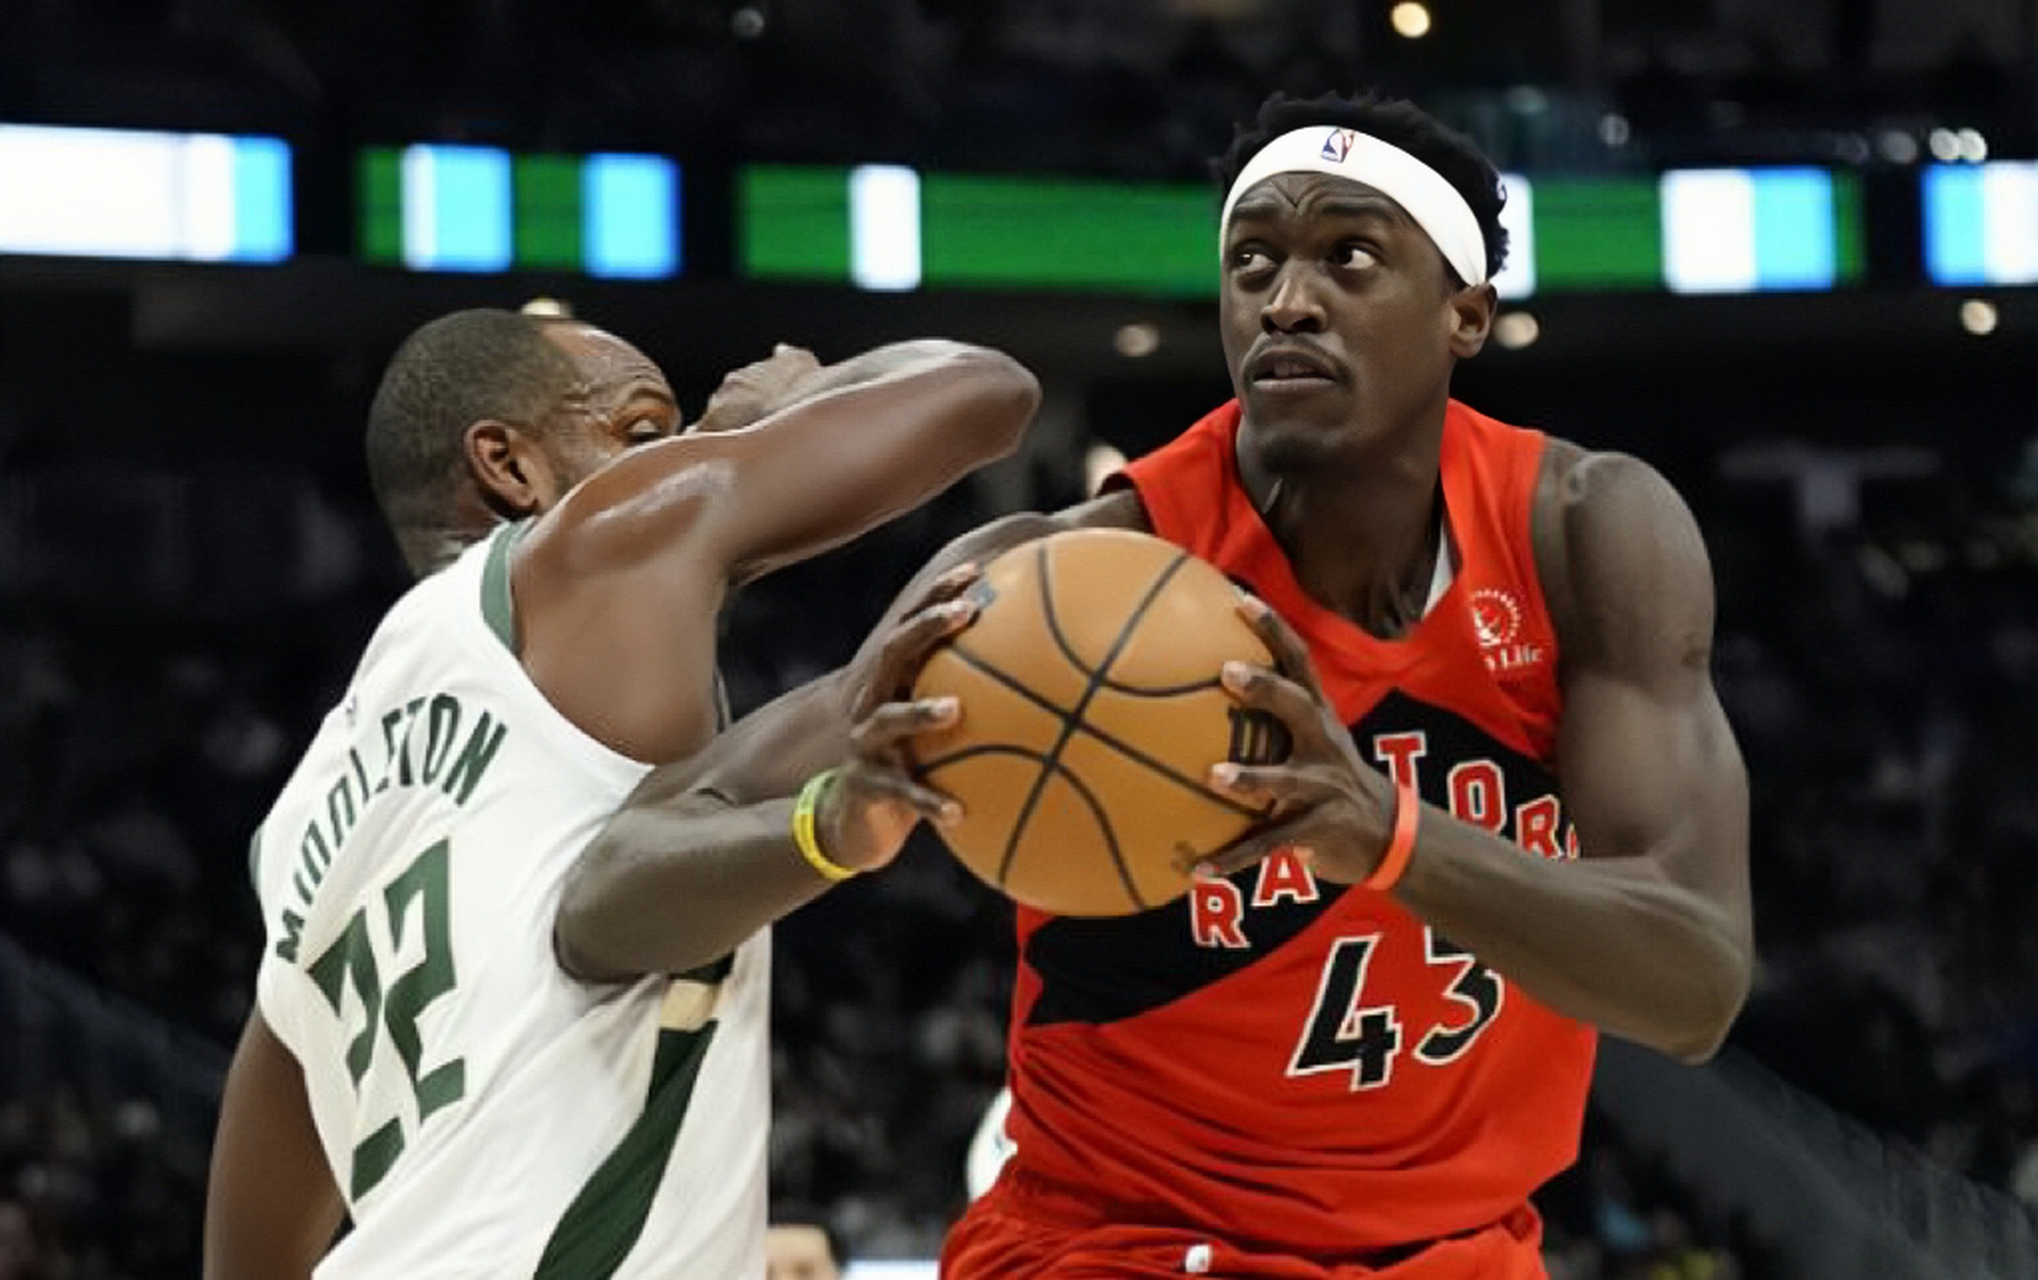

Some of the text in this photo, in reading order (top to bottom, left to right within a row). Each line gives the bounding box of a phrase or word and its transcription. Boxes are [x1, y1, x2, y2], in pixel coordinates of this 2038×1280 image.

[1189, 730, 1581, 950] RATOR
[306, 836, 466, 1203] 22
[1284, 925, 1505, 1092] 43
